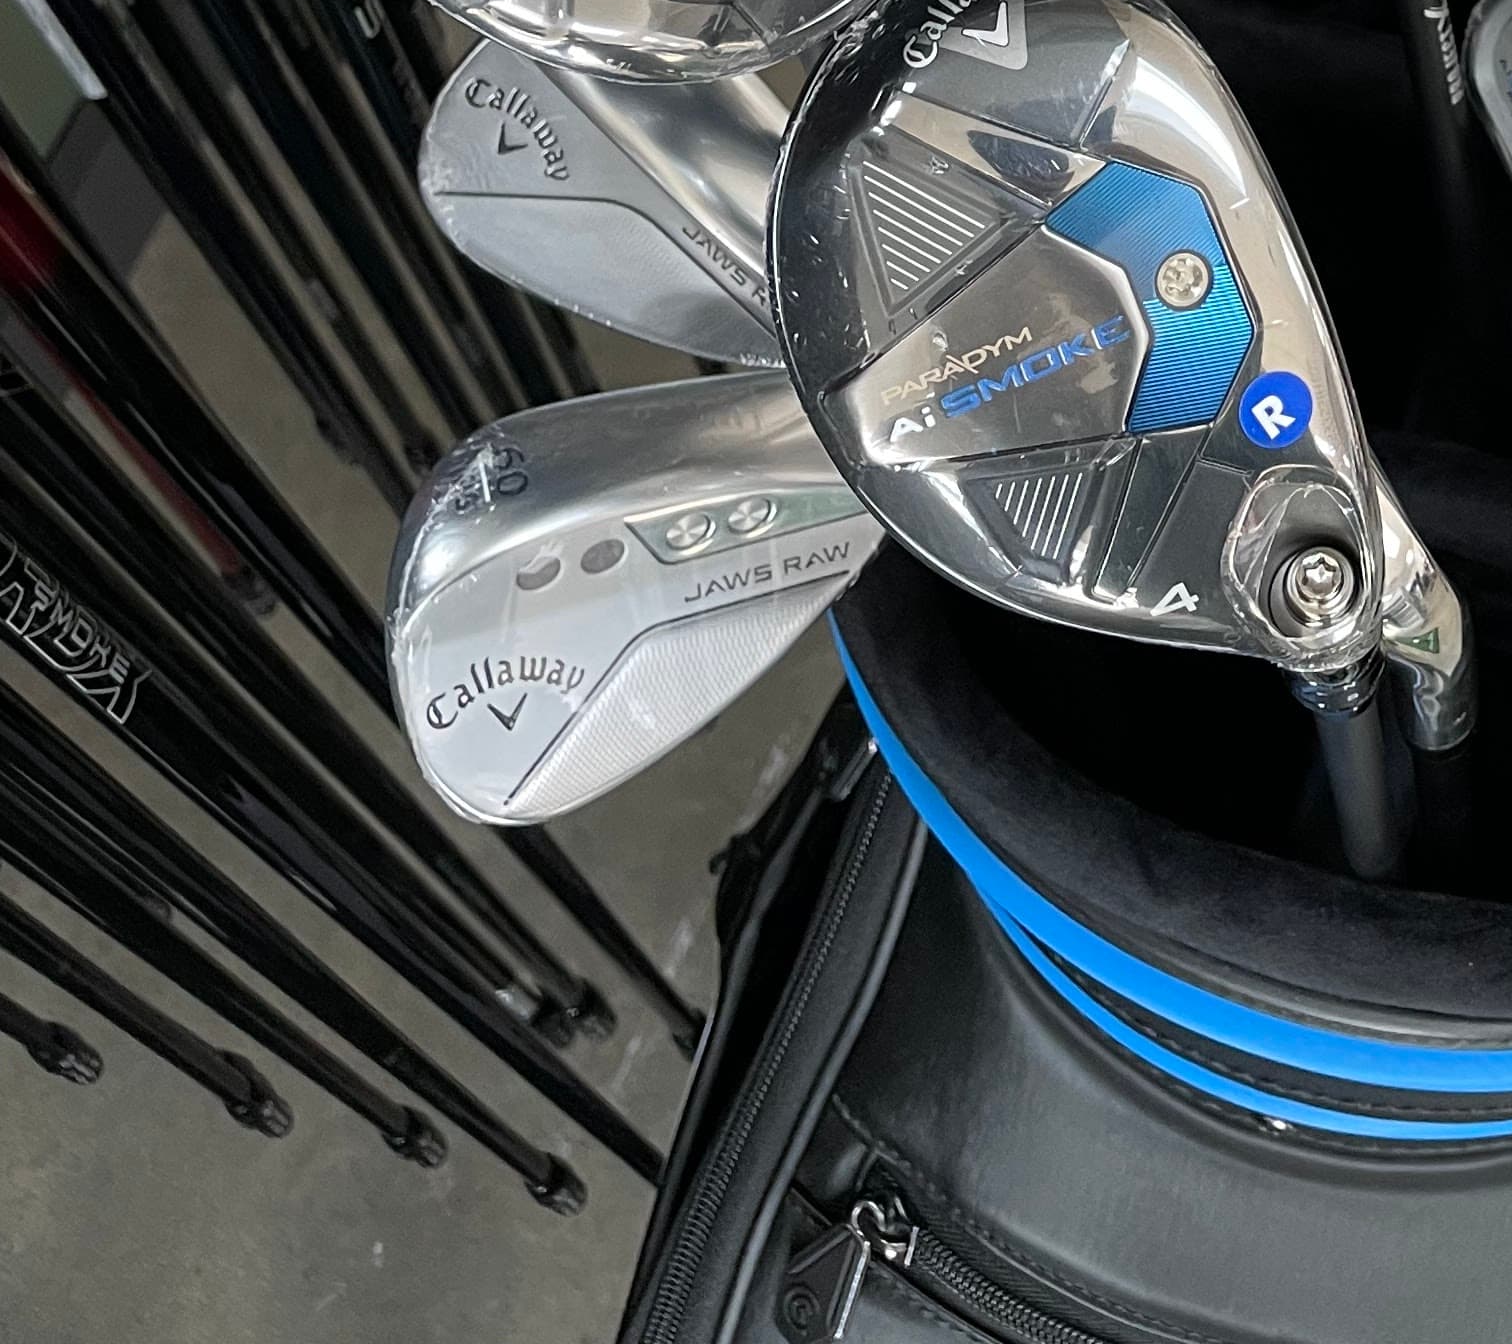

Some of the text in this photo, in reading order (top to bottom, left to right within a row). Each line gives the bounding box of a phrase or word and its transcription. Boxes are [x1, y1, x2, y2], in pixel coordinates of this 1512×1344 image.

[464, 77, 570, 182] Callaway
[682, 225, 747, 287] JAWS
[881, 326, 1033, 407] PARADYM
[888, 314, 1135, 445] Ai SMOKE
[1250, 393, 1297, 442] R
[685, 541, 851, 603] JAWS RAW
[1150, 582, 1201, 616] 4
[31, 579, 131, 686] SMOKE
[426, 654, 587, 730] Callaway
